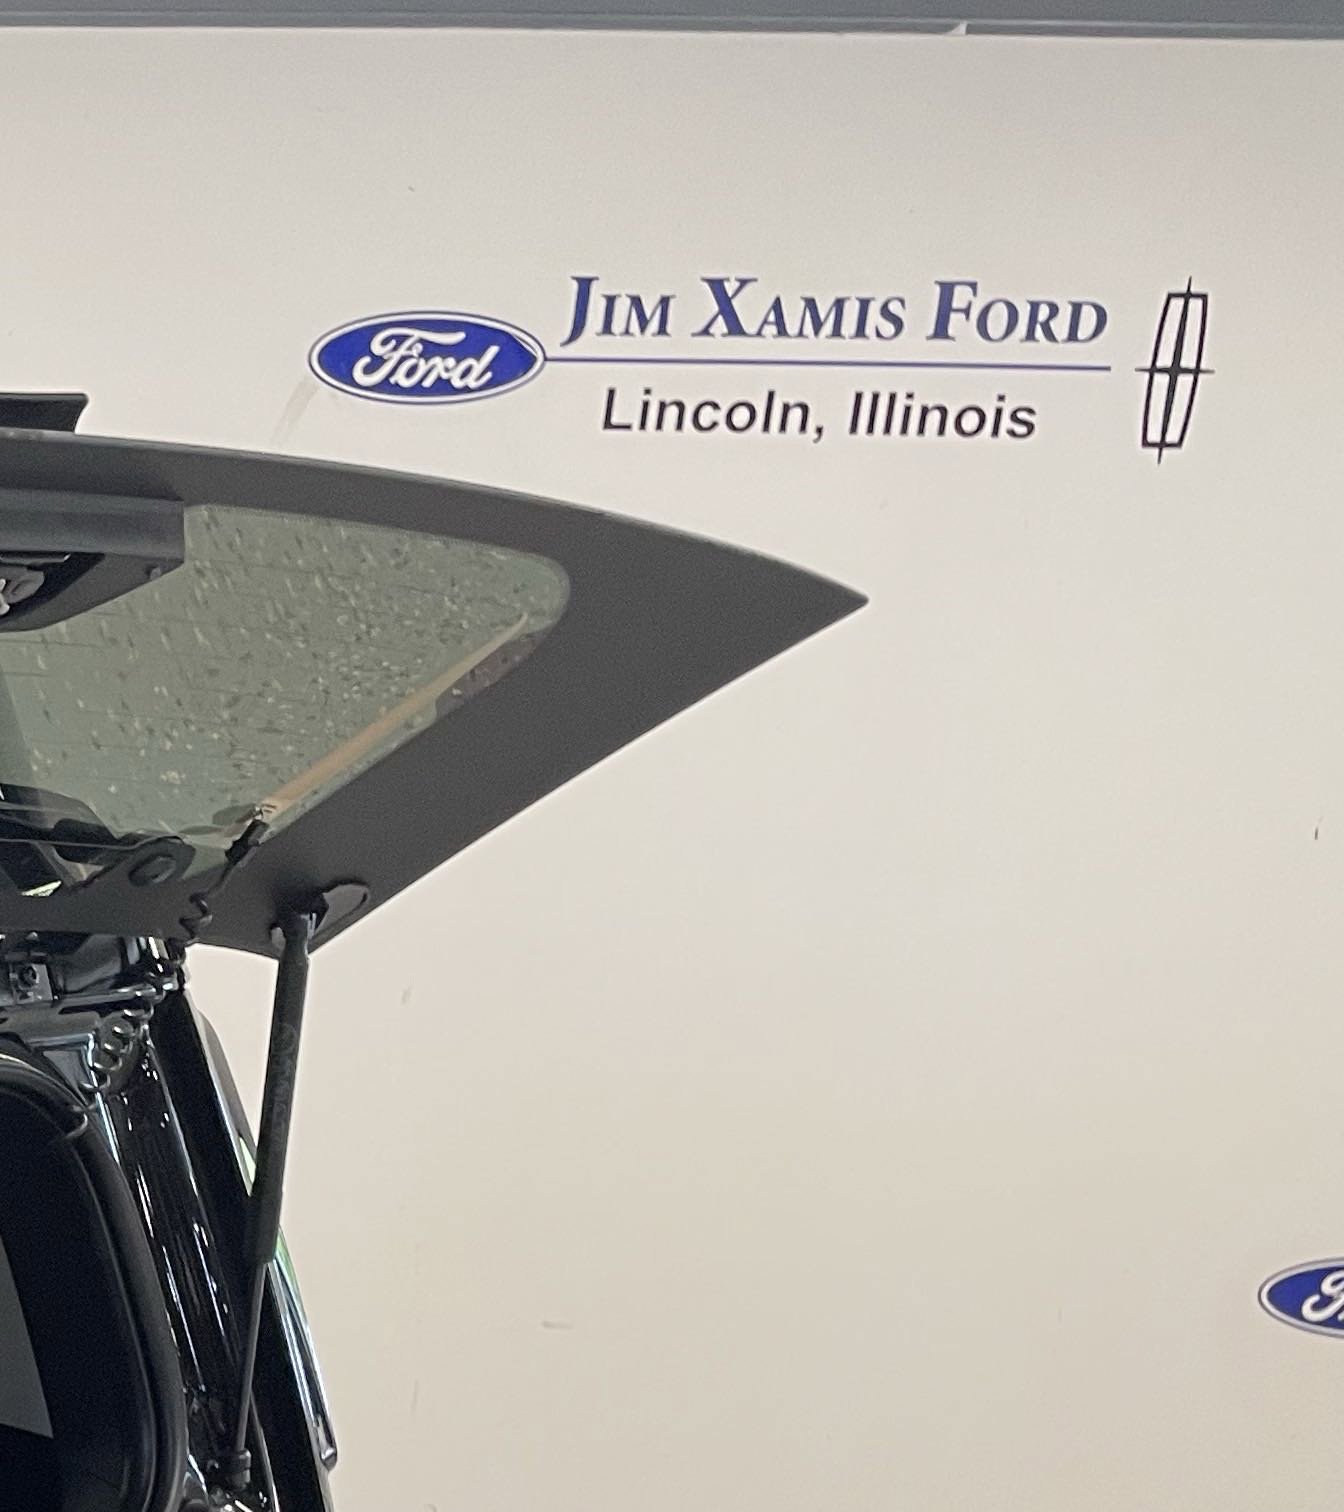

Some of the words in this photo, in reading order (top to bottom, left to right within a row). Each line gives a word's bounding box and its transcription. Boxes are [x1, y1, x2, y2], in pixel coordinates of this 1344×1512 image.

[558, 274, 676, 348] JIM
[691, 276, 906, 341] XAMIS
[926, 279, 1109, 345] FORD
[349, 327, 498, 394] Ford
[601, 386, 826, 444] Lincoln,
[848, 391, 1039, 440] Illinois
